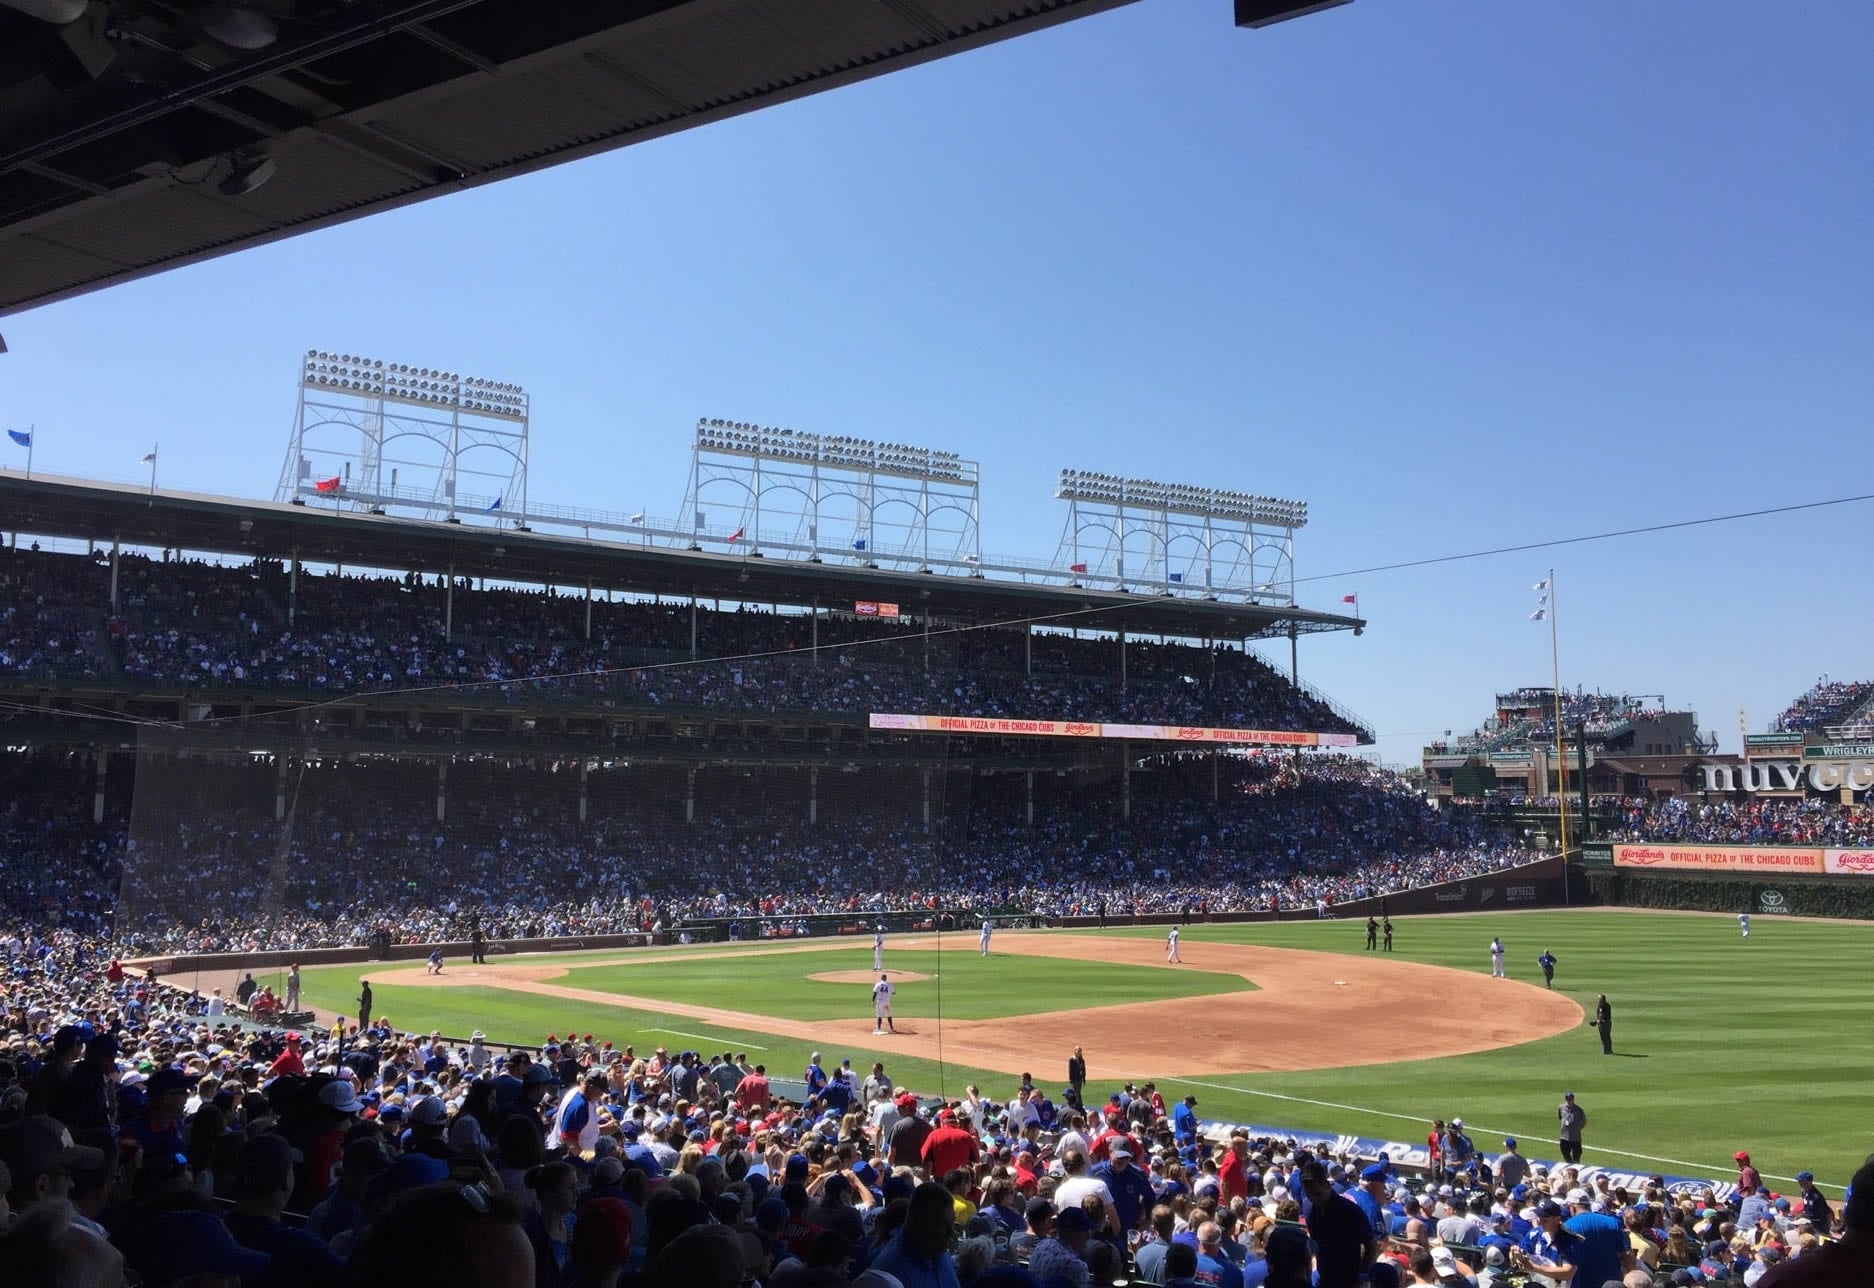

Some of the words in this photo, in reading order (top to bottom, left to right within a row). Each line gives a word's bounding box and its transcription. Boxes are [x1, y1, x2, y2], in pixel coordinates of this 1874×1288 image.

[940, 718, 968, 729] OFFICIAL
[970, 719, 988, 730] PIZZA
[998, 720, 1009, 731] THE
[1011, 721, 1037, 732] CHICAGO
[1038, 722, 1054, 732] CUBS
[1213, 729, 1233, 739] OFFICIAL
[1237, 730, 1252, 740] PIZZA
[1260, 731, 1269, 741] THE
[1271, 732, 1293, 742] CHICAGO
[1294, 733, 1307, 743] CUBS
[1670, 852, 1703, 863] OFFICIAL
[1705, 853, 1728, 864] PIZZA
[1729, 855, 1736, 863] OF
[1739, 855, 1754, 864] THE
[1756, 855, 1791, 866] CHICAGO
[1793, 856, 1815, 866] CUBS
[879, 986, 889, 994] 44
